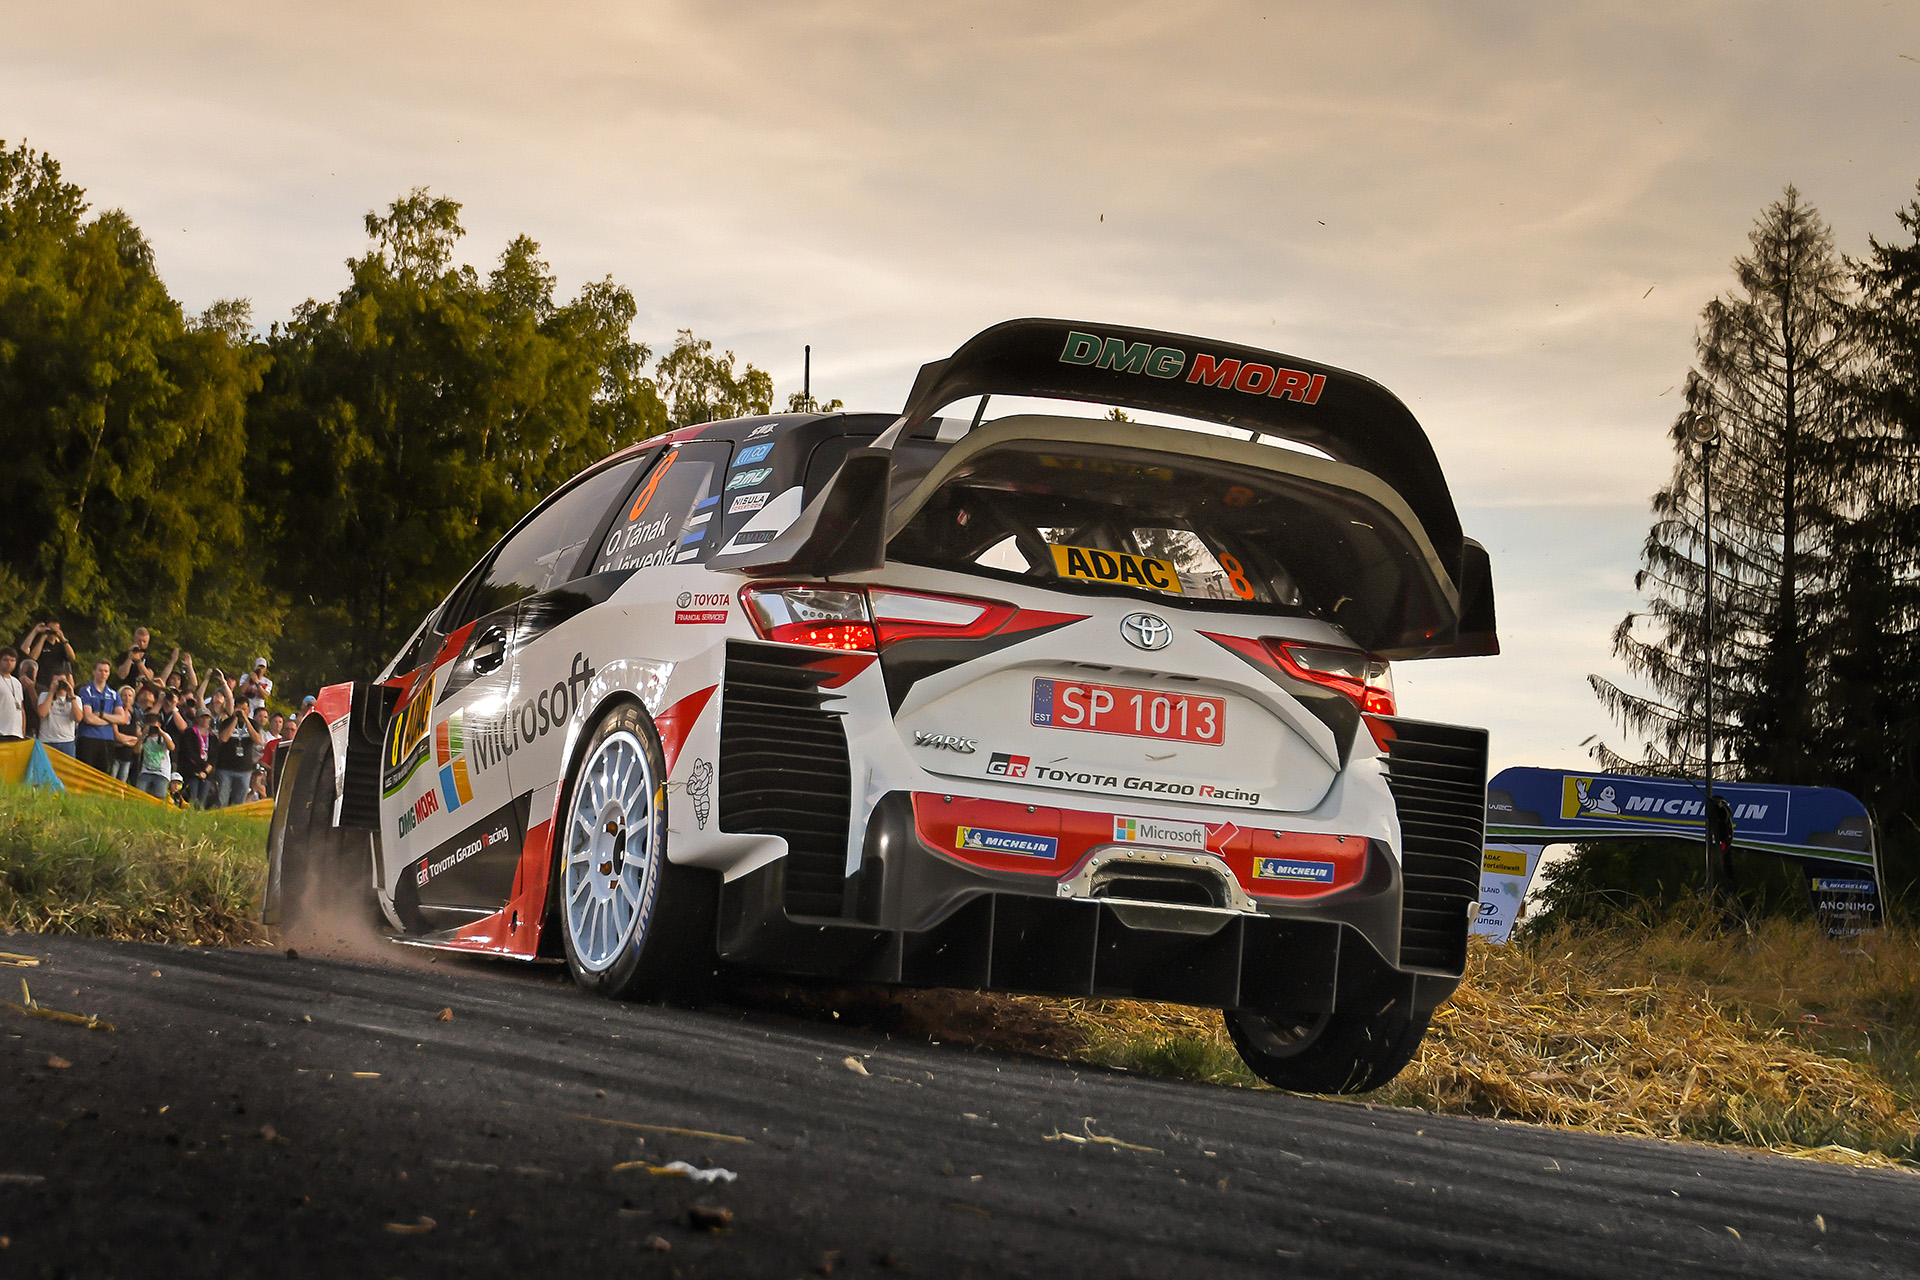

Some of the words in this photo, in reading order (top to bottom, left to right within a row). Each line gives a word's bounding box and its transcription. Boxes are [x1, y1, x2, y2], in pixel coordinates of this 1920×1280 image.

[1059, 330, 1187, 379] DMG
[1186, 353, 1327, 405] MORI
[629, 450, 679, 522] 8
[733, 495, 766, 506] NISULA
[606, 529, 622, 557] O.
[622, 512, 672, 550] Tänak
[738, 532, 774, 542] TAMADIC
[1067, 548, 1169, 589] ADAC
[1219, 552, 1255, 600] 8
[694, 593, 730, 606] TOYOTA
[677, 613, 700, 621] FINANCIAL
[701, 613, 725, 621] SERVICES
[472, 651, 596, 775] Microsoft
[1034, 712, 1051, 722] EST
[1060, 686, 1115, 727] SP
[1130, 694, 1216, 739] 1013
[391, 712, 404, 767] 8
[988, 761, 1028, 777] GR
[1034, 766, 1117, 788] TOYOTA
[1123, 777, 1195, 796] GAZOO
[1199, 784, 1261, 805] Racing
[398, 805, 417, 839] DMG
[414, 789, 439, 824] MORI
[1625, 796, 1769, 820] MICHIN
[985, 837, 1049, 852] MICHELIN
[1140, 824, 1202, 844] Microsoft
[429, 855, 456, 878] TOYOTA
[456, 840, 483, 862] GAZOO
[482, 826, 509, 850] Racing
[1484, 854, 1501, 862] ADAC
[1277, 865, 1328, 877] MICHELIN
[634, 836, 661, 947] MICHELIN
[1820, 901, 1875, 912] ANONIMO
